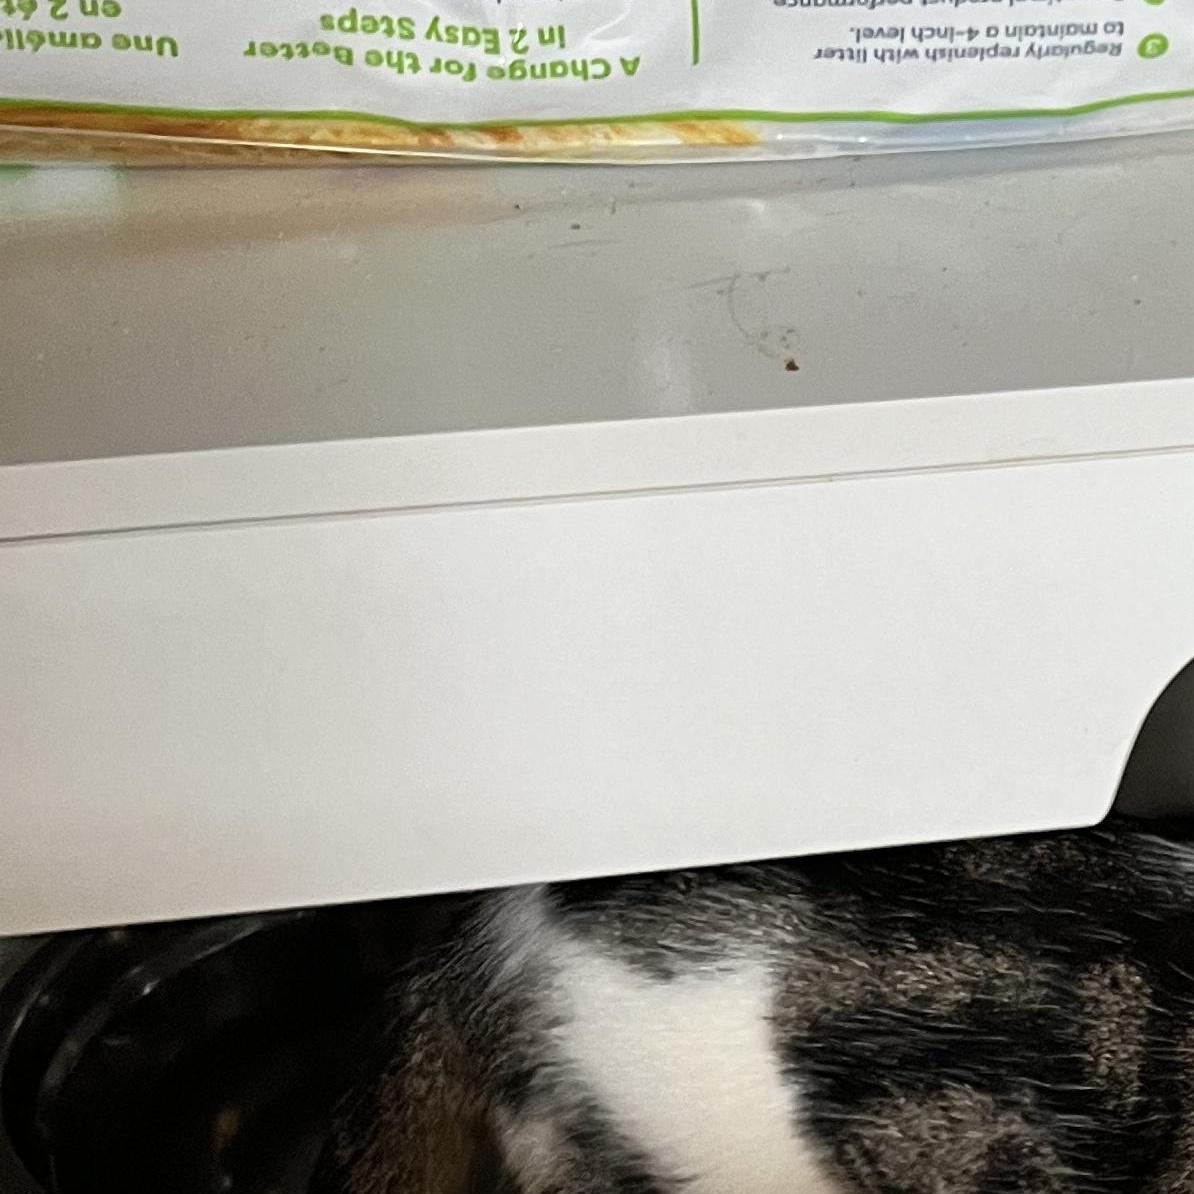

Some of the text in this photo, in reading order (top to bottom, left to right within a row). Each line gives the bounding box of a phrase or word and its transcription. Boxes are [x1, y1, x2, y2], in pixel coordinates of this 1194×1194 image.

[0, 0, 121, 20] en 2 ét
[320, 8, 565, 54] in 2 Easy Steps
[850, 21, 1124, 43] to maintain a 4-inch level.
[0, 28, 178, 57] Une améli
[925, 43, 1020, 62] replenish
[1024, 41, 1122, 60] Regularly
[244, 42, 640, 82] A Change for the Better
[814, 47, 868, 64] litter
[873, 45, 919, 64] with
